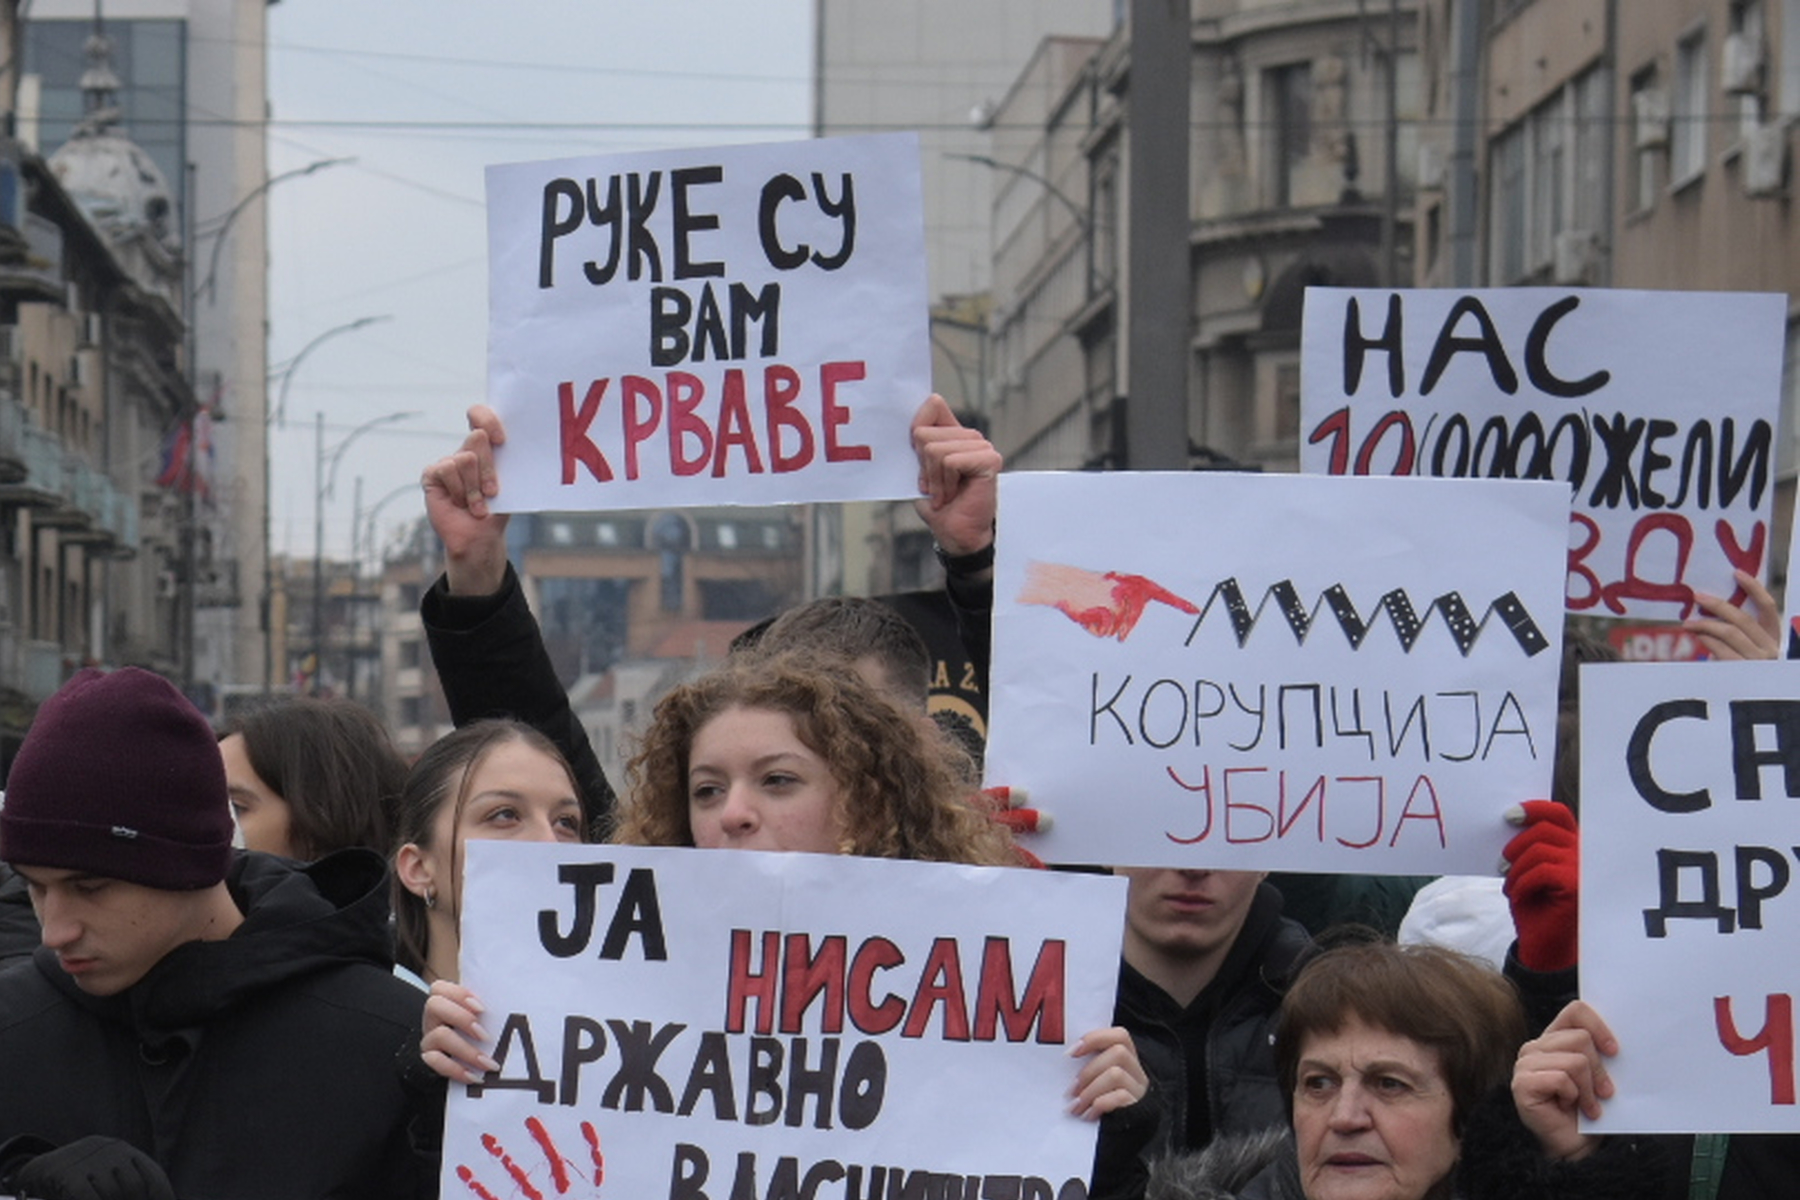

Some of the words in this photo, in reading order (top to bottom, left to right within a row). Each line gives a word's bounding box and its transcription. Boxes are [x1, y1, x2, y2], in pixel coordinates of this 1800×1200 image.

[539, 166, 725, 289] РУКЕ
[758, 172, 856, 271] СУ
[650, 280, 781, 367] ВАМ
[1343, 293, 1611, 398] НАС
[557, 360, 872, 485] КРВАВЕ
[1589, 410, 1773, 512] ЖЕЛИ
[1091, 672, 1538, 762] КОРУПЦИЈА
[1165, 764, 1446, 849] УБИЈА
[1642, 844, 1800, 938] ДР
[537, 861, 668, 961] ЈА
[724, 928, 1066, 1044] НИСАМ
[466, 1012, 888, 1131] ДРЖАВНО
